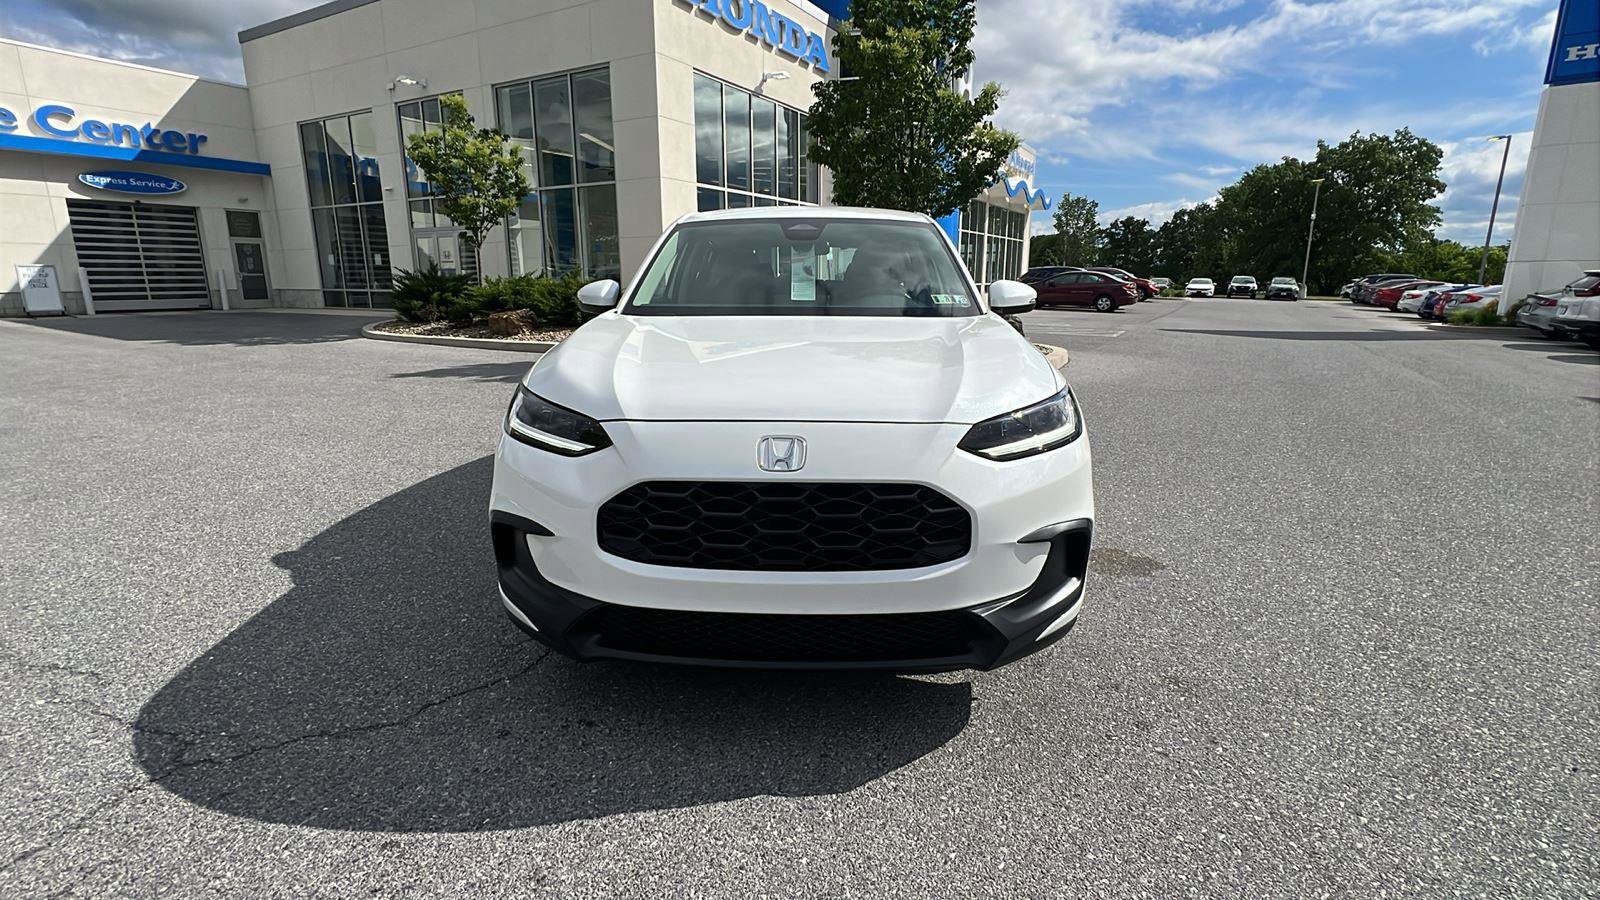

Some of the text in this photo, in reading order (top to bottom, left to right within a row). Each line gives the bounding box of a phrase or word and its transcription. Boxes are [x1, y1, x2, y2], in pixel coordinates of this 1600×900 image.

[1564, 44, 1600, 61] H
[34, 104, 208, 154] Center
[86, 174, 166, 188] Express Service
